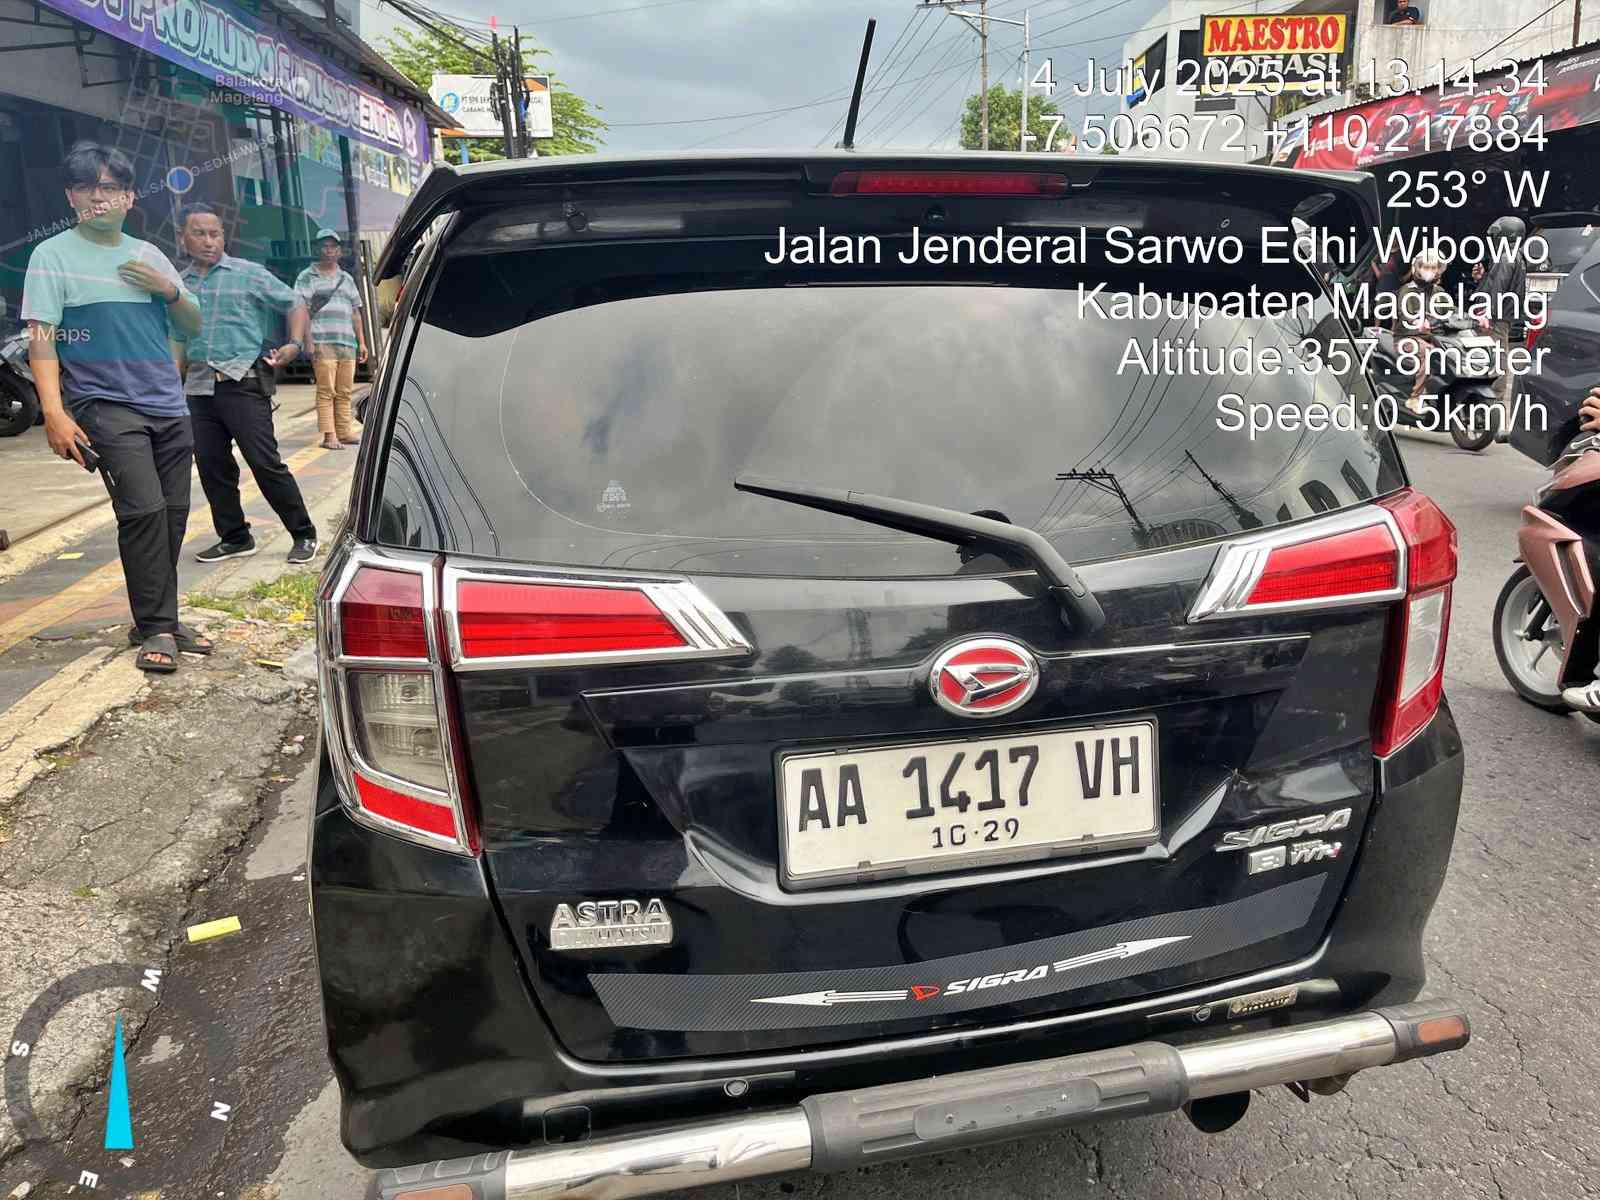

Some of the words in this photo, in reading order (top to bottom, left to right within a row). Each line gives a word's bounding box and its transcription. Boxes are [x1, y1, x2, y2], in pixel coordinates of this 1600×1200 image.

[1207, 16, 1340, 53] MAESTRO
[799, 764, 867, 832] AA
[902, 745, 1039, 819] 1417
[1075, 736, 1140, 799] VH
[1215, 808, 1352, 852] SIGRA
[550, 898, 672, 929] ASTRA
[943, 965, 1049, 996] SIGRA
